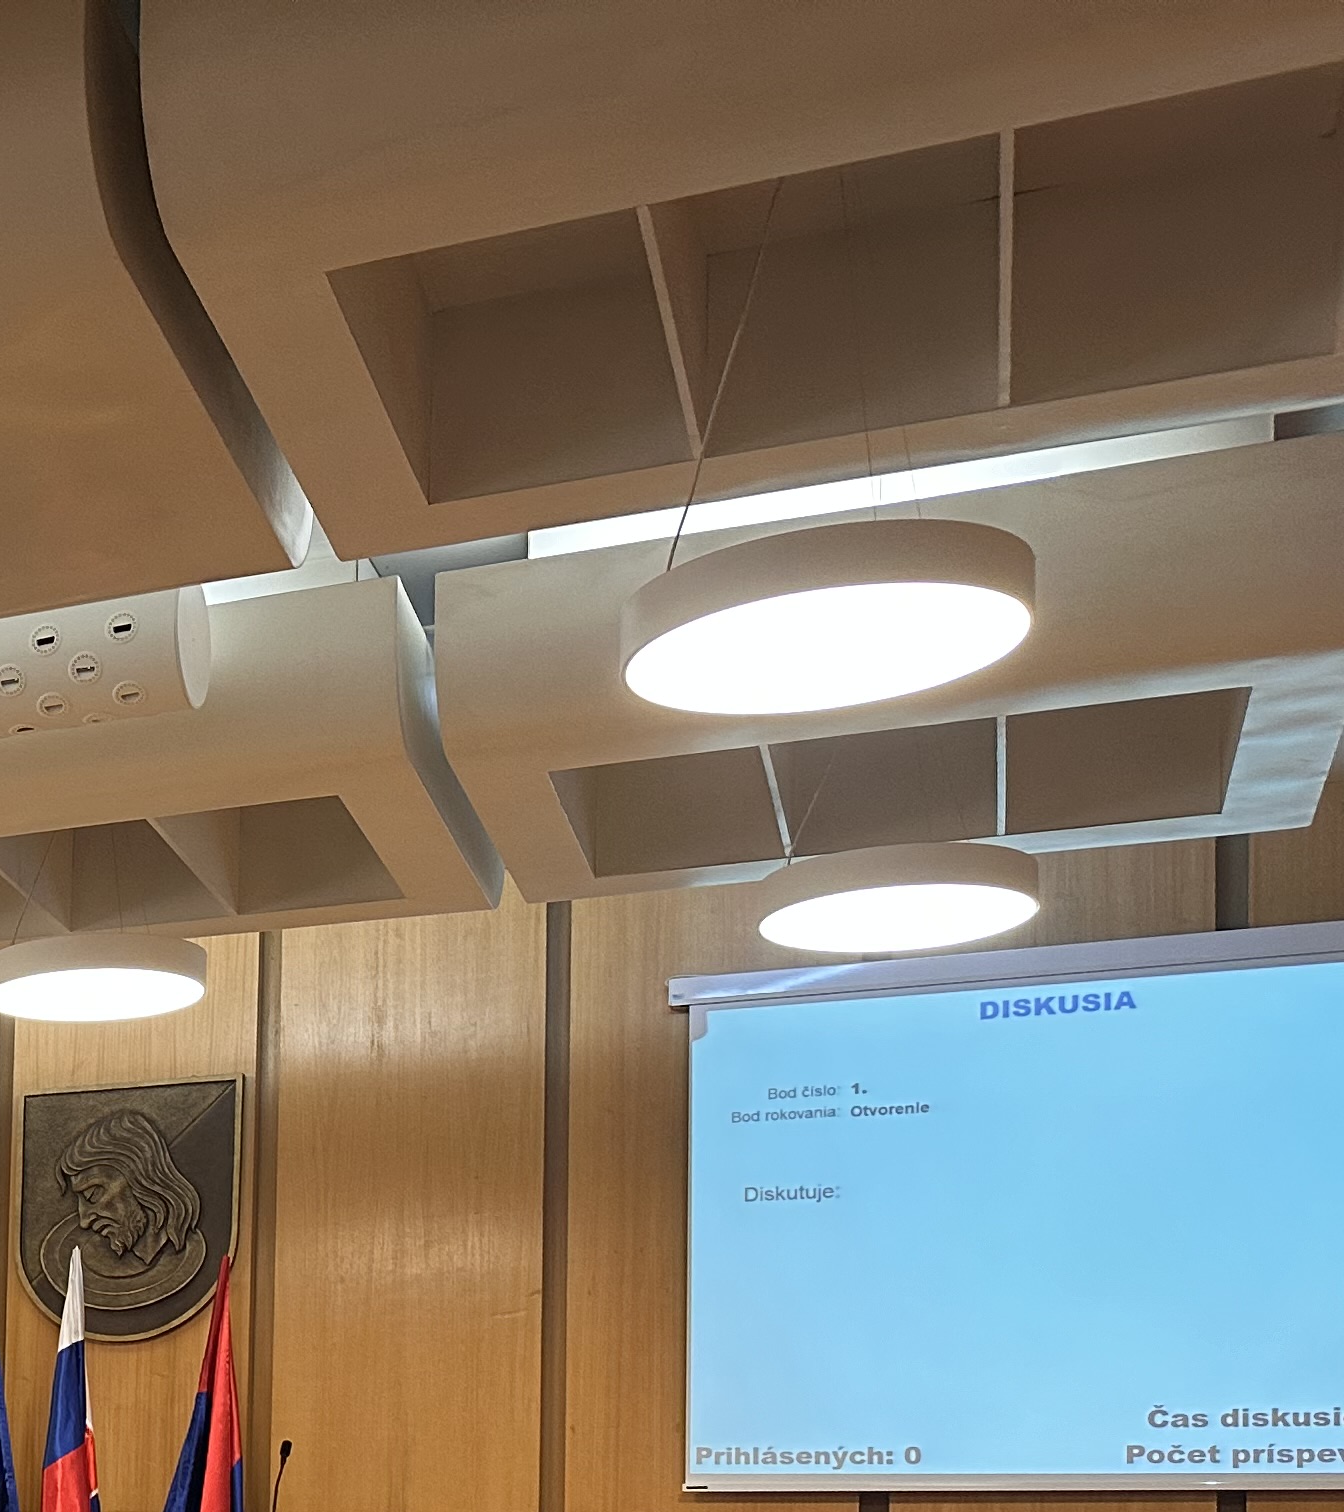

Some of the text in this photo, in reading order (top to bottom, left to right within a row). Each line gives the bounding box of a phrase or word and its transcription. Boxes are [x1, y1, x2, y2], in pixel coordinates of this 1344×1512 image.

[980, 991, 1137, 1020] DISKUSIA
[767, 1083, 868, 1100] Bod číslo: 1.
[731, 1101, 930, 1123] Bod rokovania: Otvorenie
[744, 1184, 841, 1203] Diskutuje:
[1147, 1405, 1344, 1428] Čas diskusi
[695, 1445, 922, 1470] Prihlásených: 0
[1126, 1444, 1221, 1465] Počet
